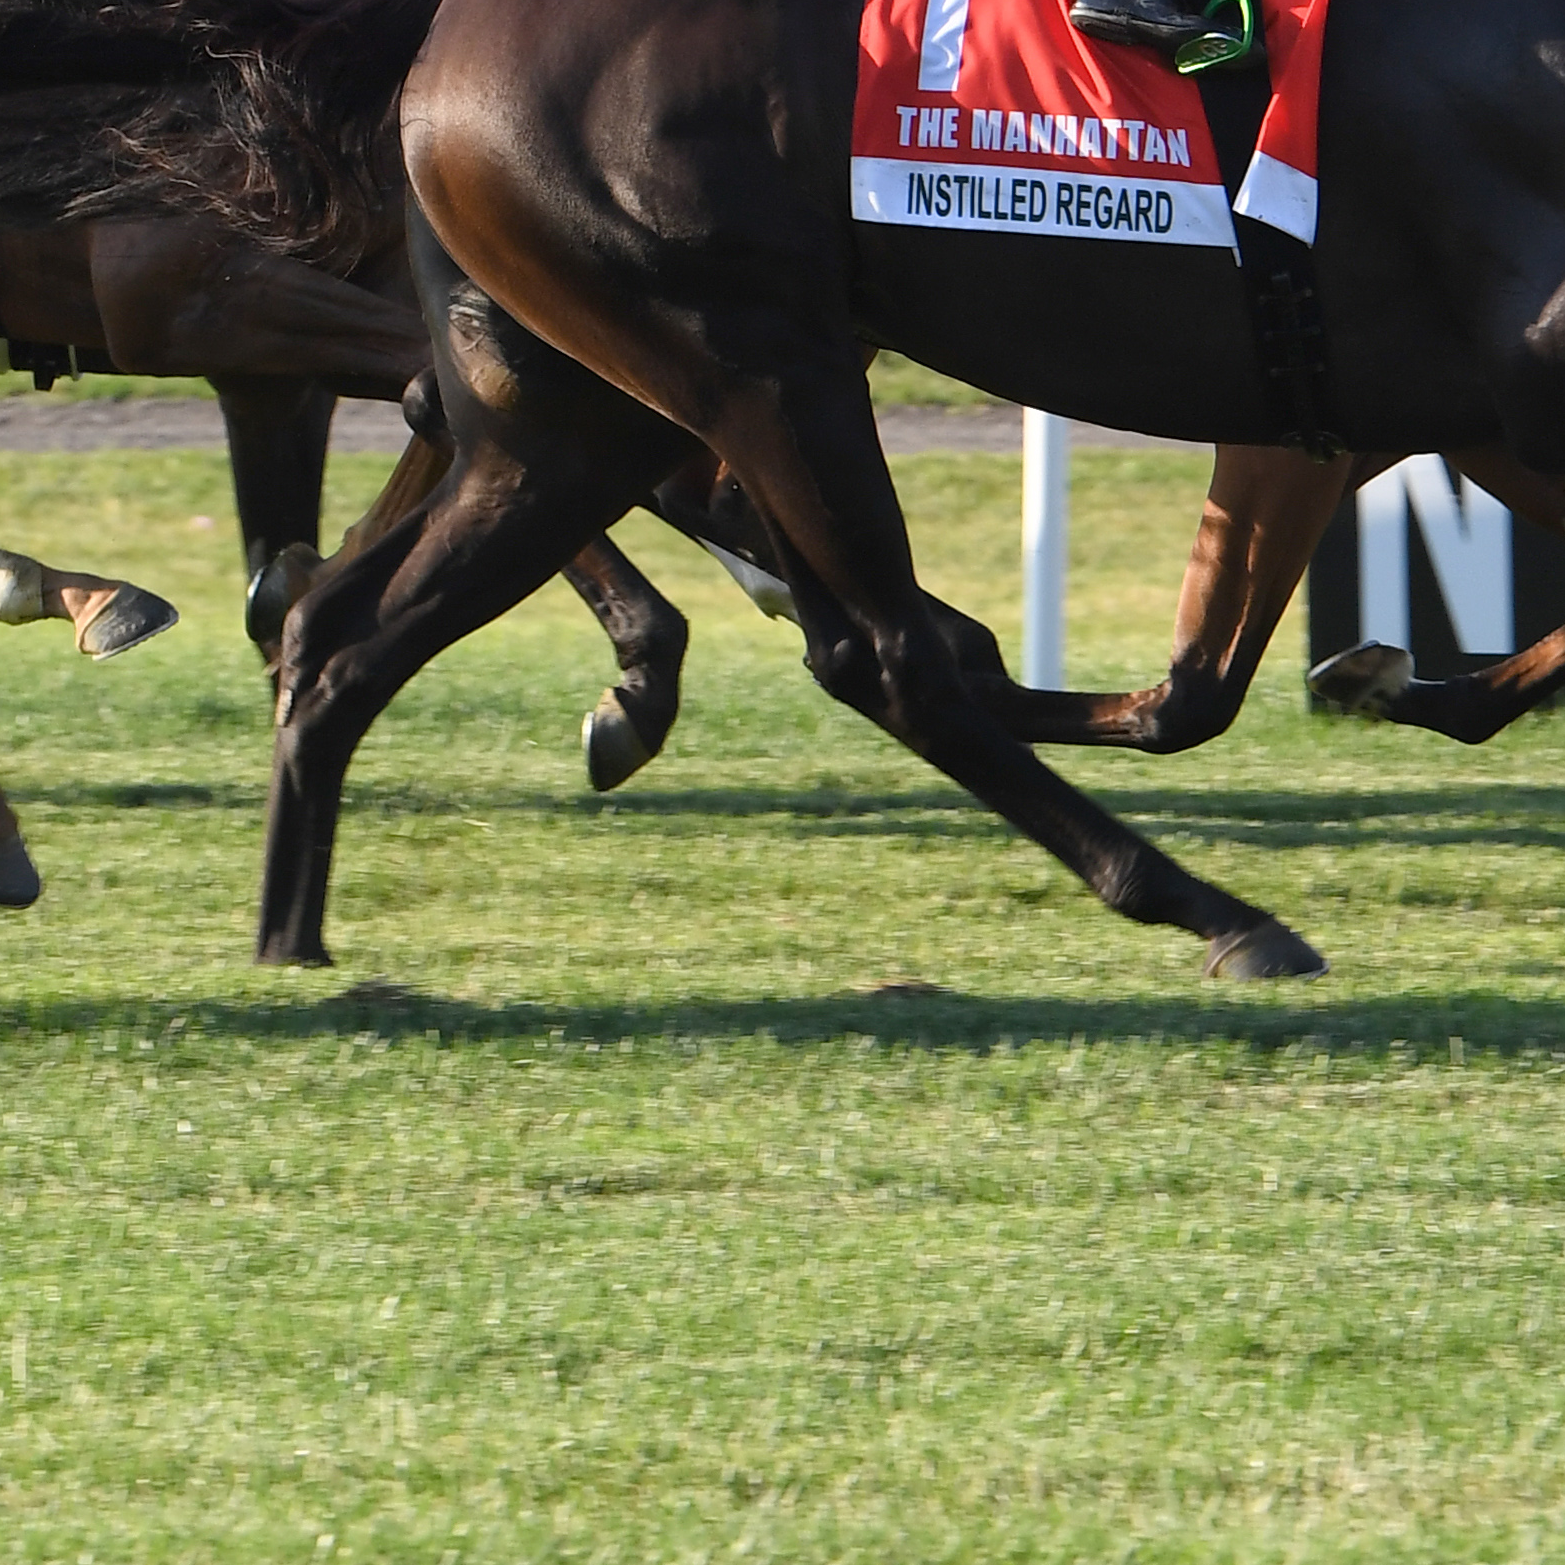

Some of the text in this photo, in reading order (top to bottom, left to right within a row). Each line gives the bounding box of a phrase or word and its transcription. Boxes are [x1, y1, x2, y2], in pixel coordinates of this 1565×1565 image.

[896, 105, 1192, 168] THE MANHATTAN
[906, 172, 1174, 234] INSTILLED REGARD
